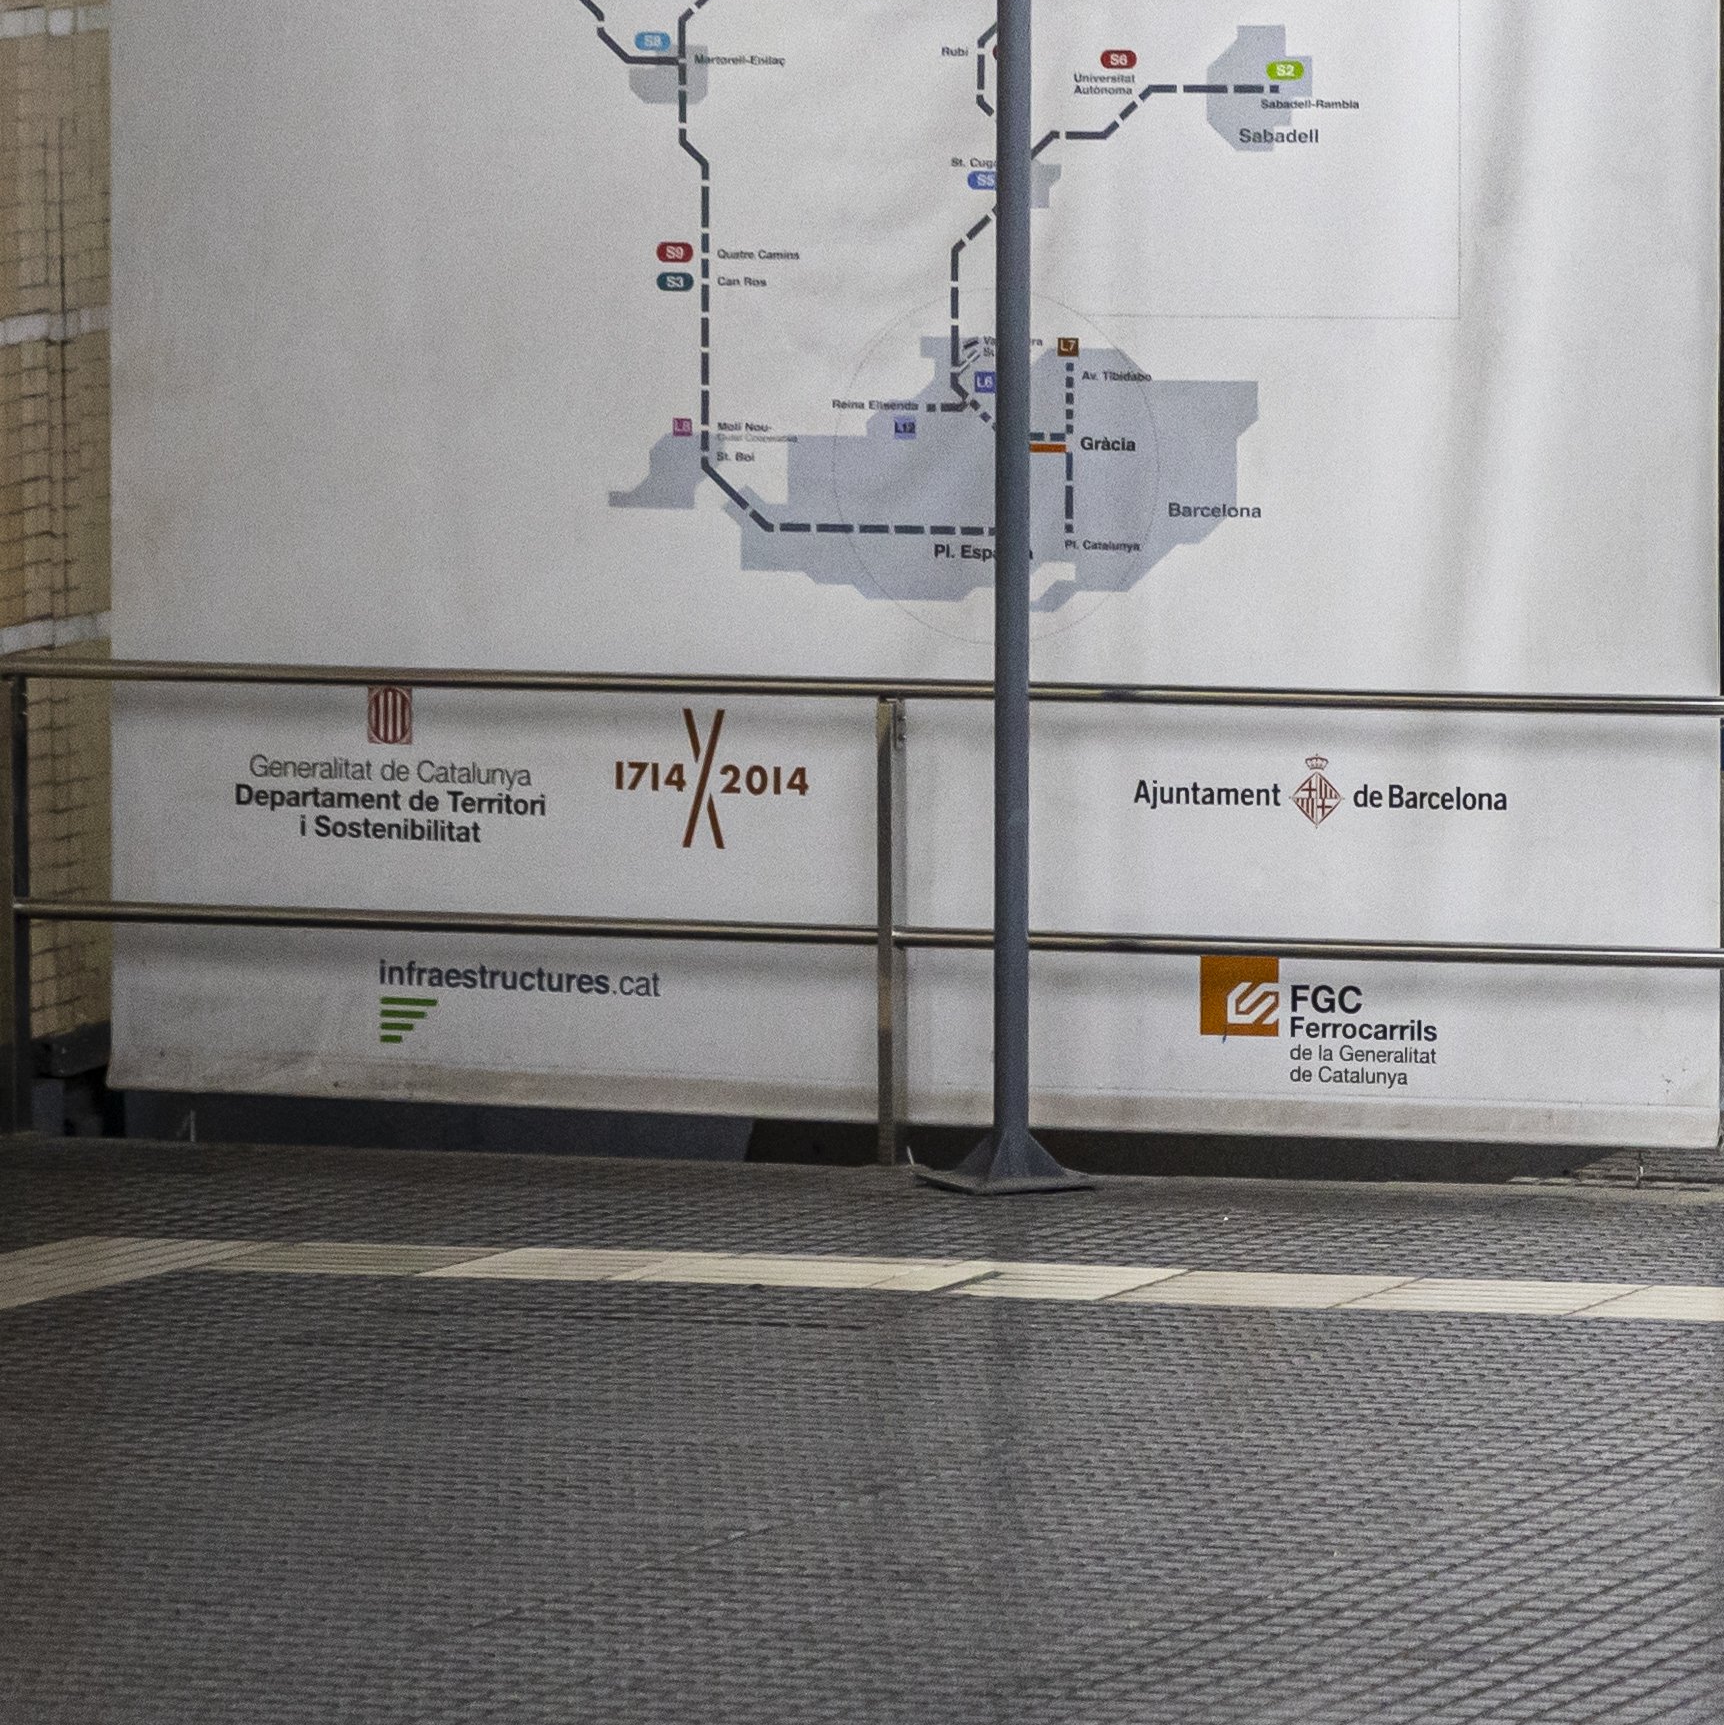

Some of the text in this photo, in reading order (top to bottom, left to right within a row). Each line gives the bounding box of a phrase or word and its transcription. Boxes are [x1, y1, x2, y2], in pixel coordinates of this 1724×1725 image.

[1110, 54, 1128, 66] S6
[1239, 128, 1319, 145] Sabadell
[1060, 339, 1076, 352] L7
[1080, 435, 1136, 452] Gràcia
[1168, 501, 1262, 518] Barcelona
[934, 543, 955, 558] Pl.
[1083, 540, 1140, 552] Catalunya
[249, 754, 532, 789] Generalitat de Catalunya
[614, 761, 808, 796] 1714 2014
[235, 784, 546, 817] Departament de Territori
[1134, 779, 1508, 811] Ajuntament de Barcelona
[300, 815, 481, 844] i Sostenibilitat
[379, 960, 661, 998] infraestructures.cat
[1290, 984, 1363, 1014] FGC
[1290, 1016, 1438, 1044] Ferrocarrils
[1290, 1044, 1436, 1066] de la Generalitat
[1290, 1065, 1408, 1089] de Catalunya
